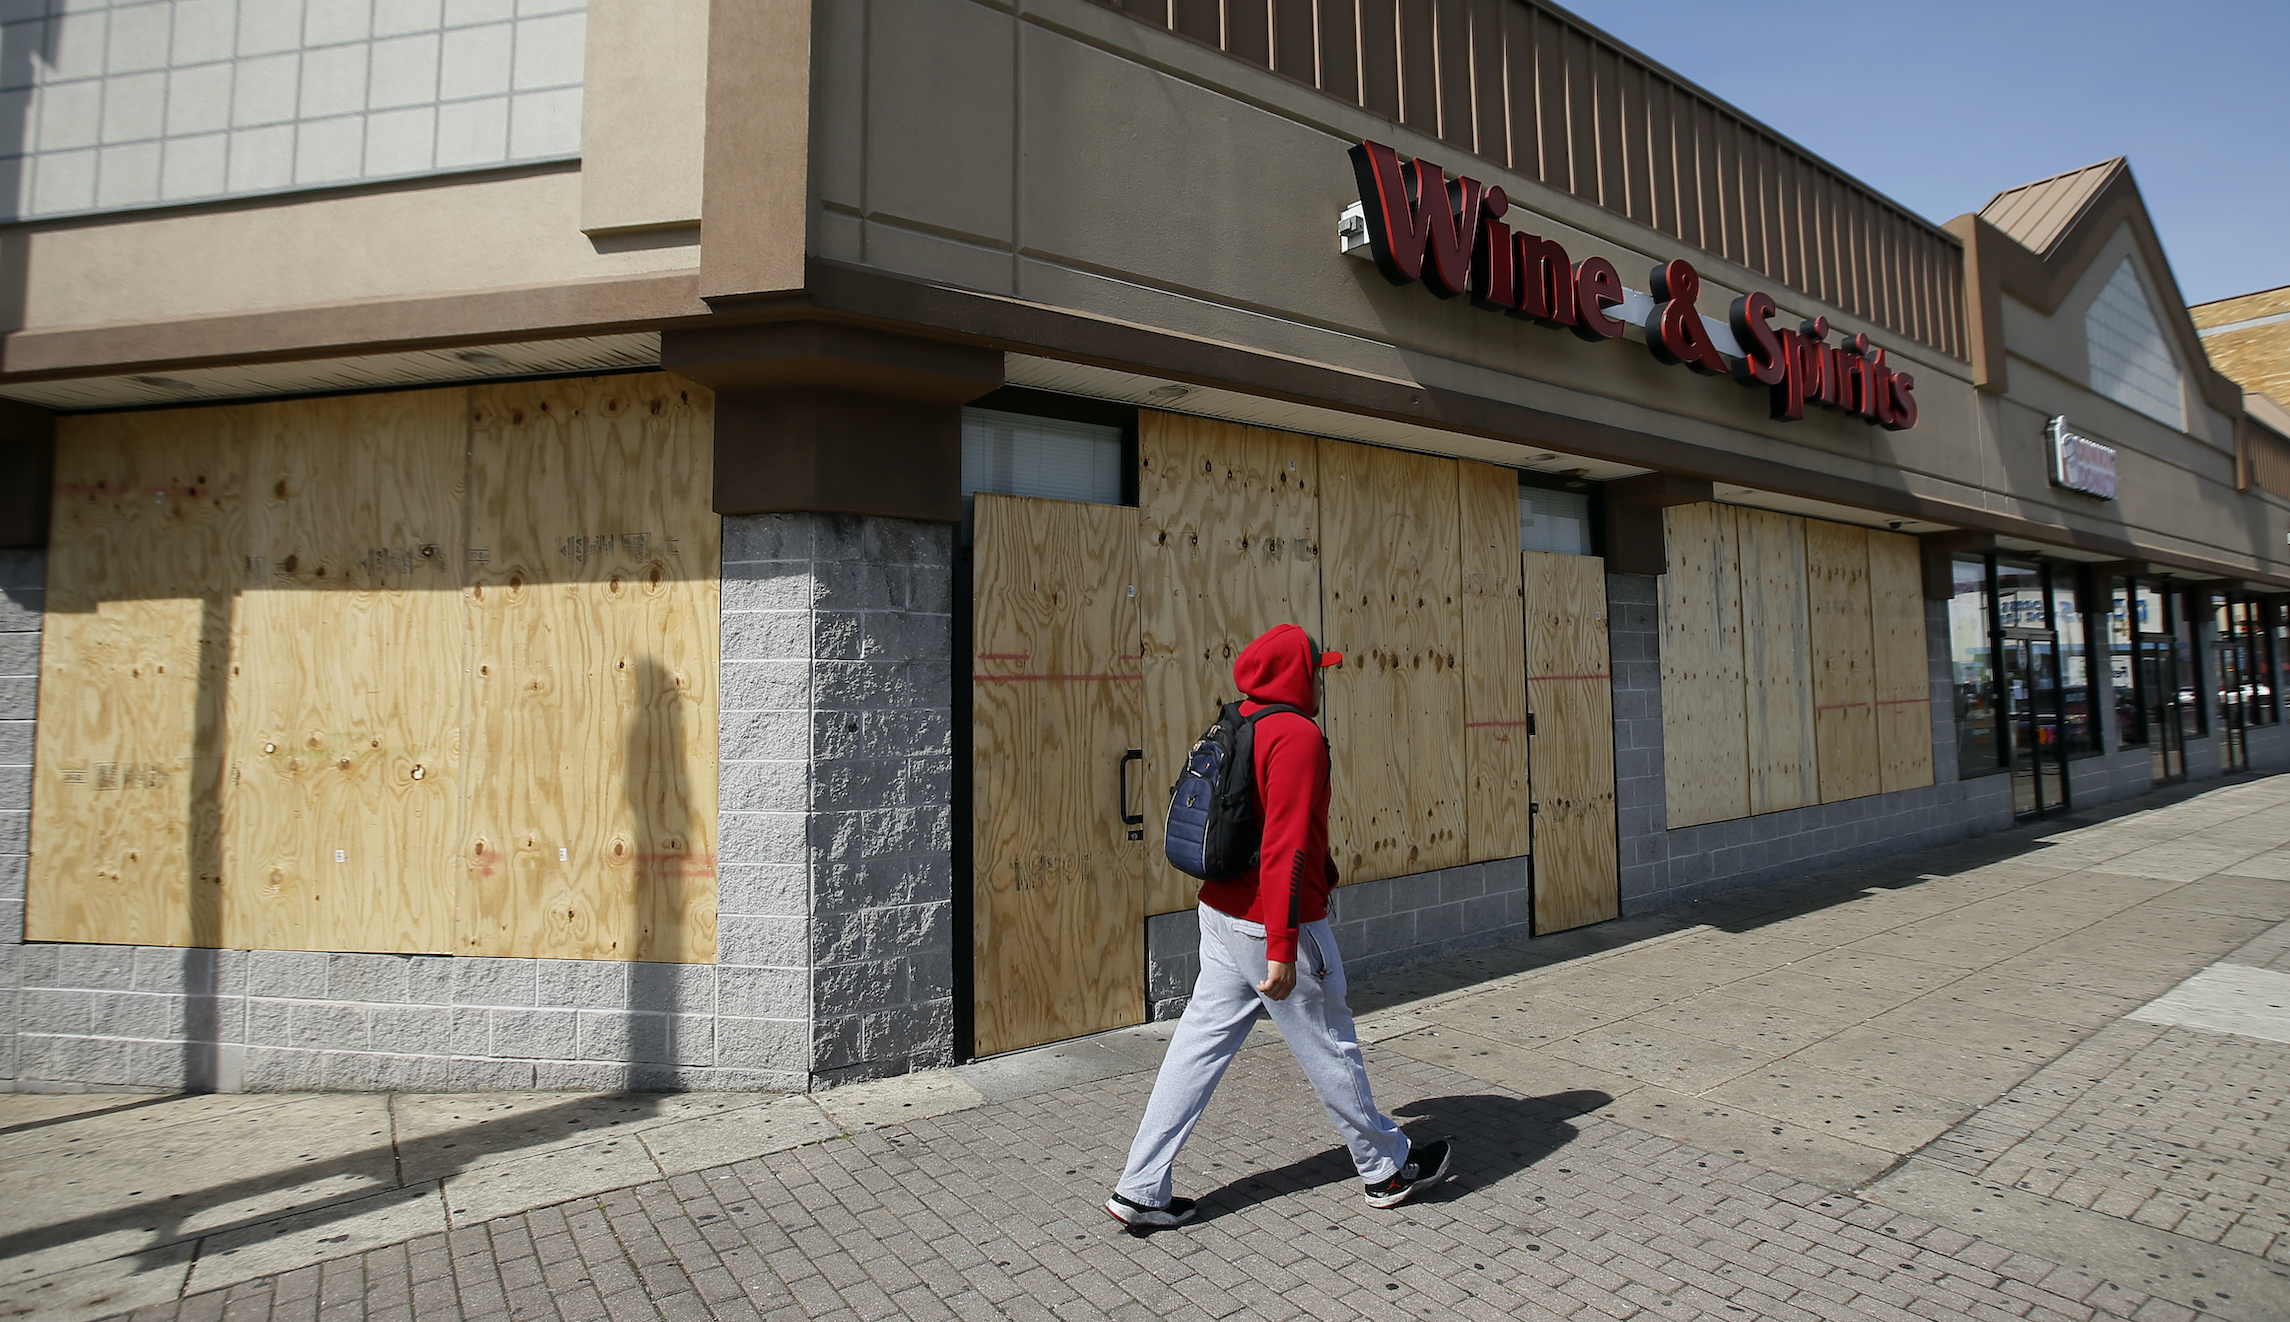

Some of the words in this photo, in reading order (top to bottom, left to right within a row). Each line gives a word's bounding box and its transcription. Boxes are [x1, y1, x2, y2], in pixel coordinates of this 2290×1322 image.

[1349, 139, 1625, 342] Wine
[1646, 259, 1729, 376] &
[1732, 291, 1919, 431] Spirits
